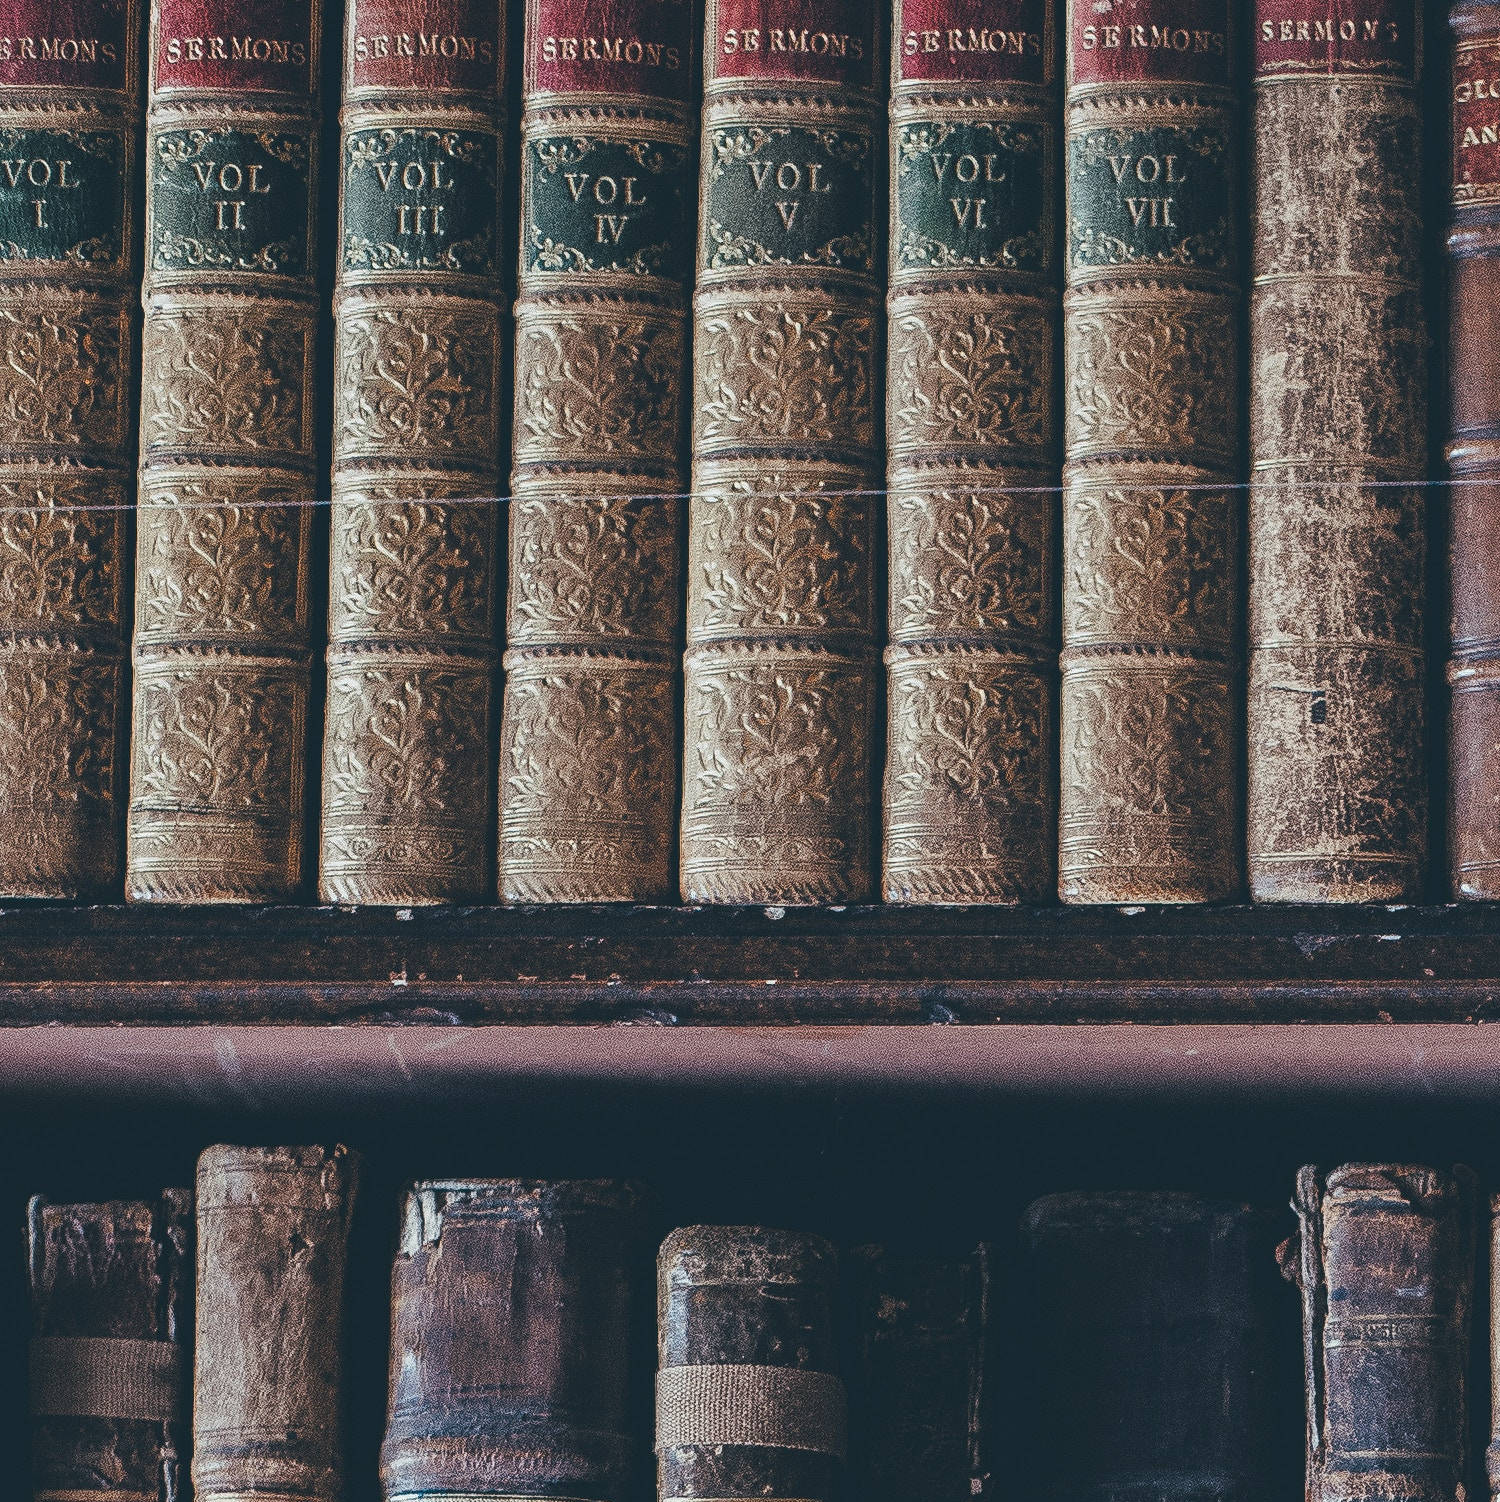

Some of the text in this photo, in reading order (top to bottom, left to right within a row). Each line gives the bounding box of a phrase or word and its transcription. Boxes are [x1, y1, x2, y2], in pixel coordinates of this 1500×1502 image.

[723, 27, 864, 60] SERMONS
[904, 28, 1042, 57] SERMONS
[1082, 26, 1224, 57] SERMONS
[1262, 18, 1399, 44] SERMONS
[0, 35, 116, 63] ERMONS
[166, 37, 305, 65] SERMONS
[355, 35, 492, 65] SERMONS
[541, 36, 681, 69] SERMONS
[1, 158, 81, 190] VOL
[194, 162, 271, 194] VOL
[374, 160, 454, 191] VOL
[748, 161, 832, 194] VOL
[930, 153, 1007, 184] VOL
[1106, 154, 1187, 185] VOL
[565, 173, 647, 206] VOL
